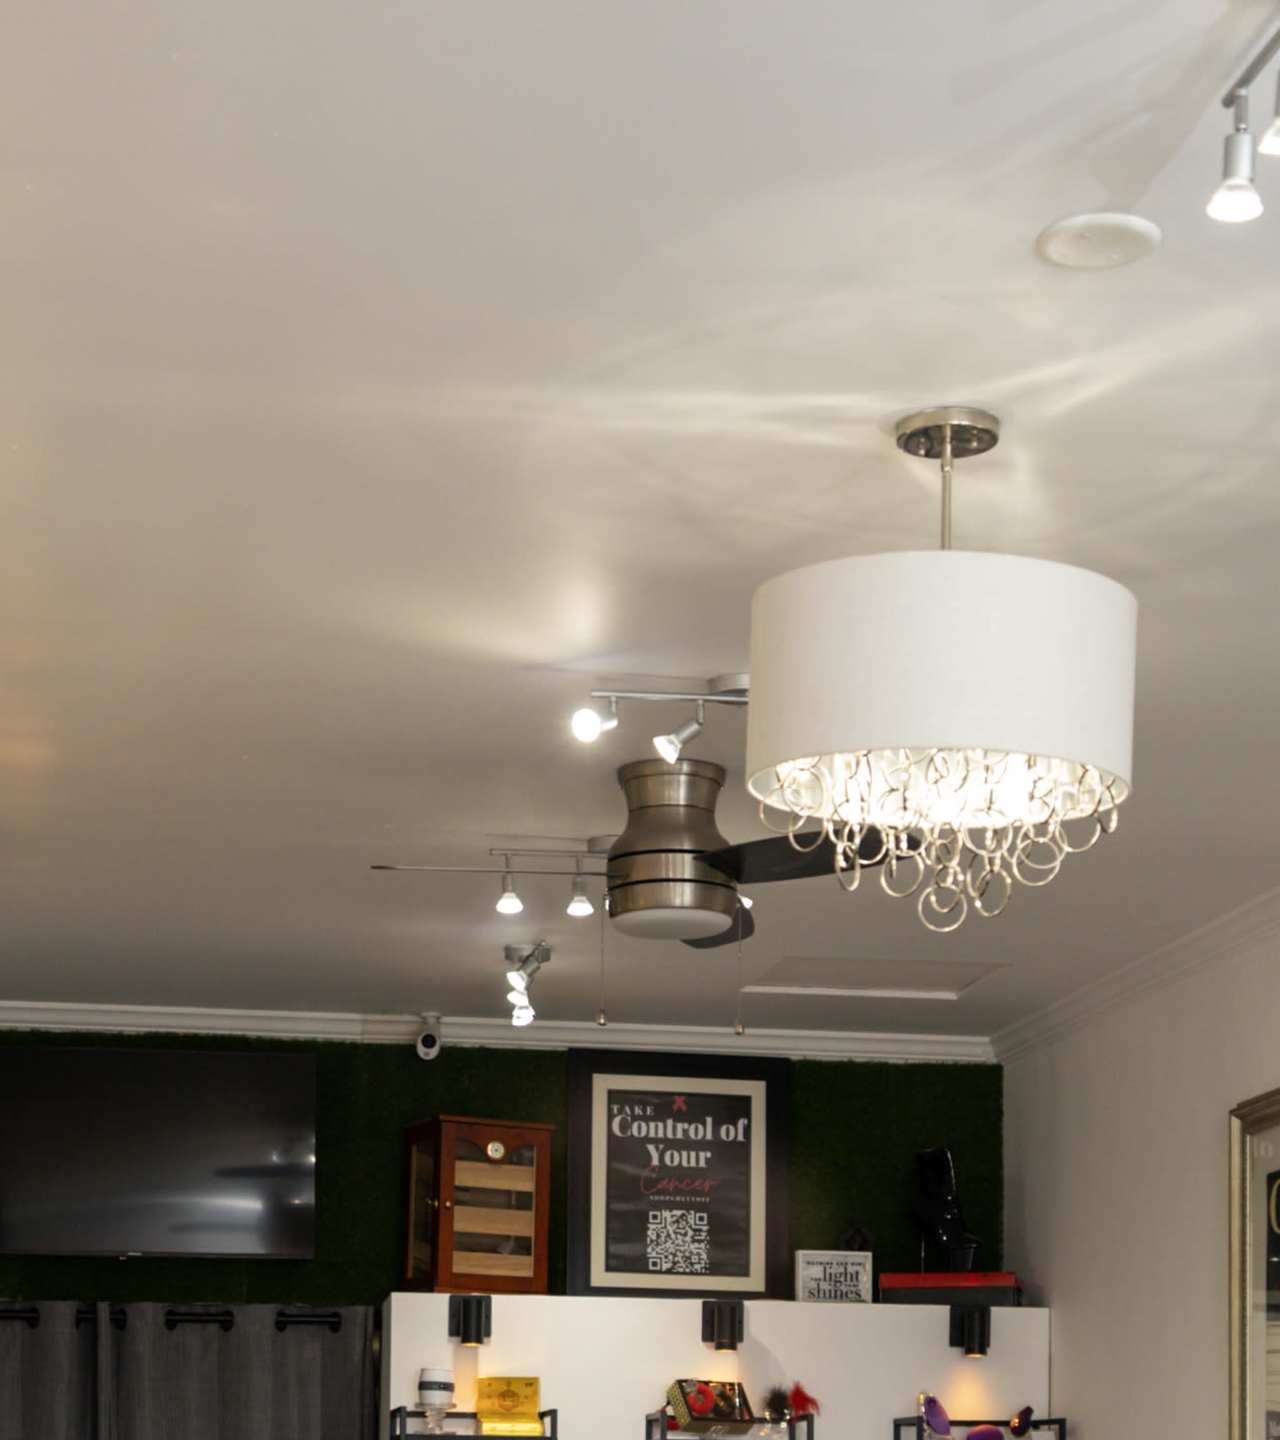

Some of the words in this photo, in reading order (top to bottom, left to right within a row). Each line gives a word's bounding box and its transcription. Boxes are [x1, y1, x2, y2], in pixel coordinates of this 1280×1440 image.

[611, 1105, 655, 1116] TAKE
[611, 1114, 713, 1140] Control
[719, 1117, 748, 1142] of
[645, 1143, 712, 1168] Your
[823, 1265, 859, 1289] light
[807, 1282, 862, 1300] shines
